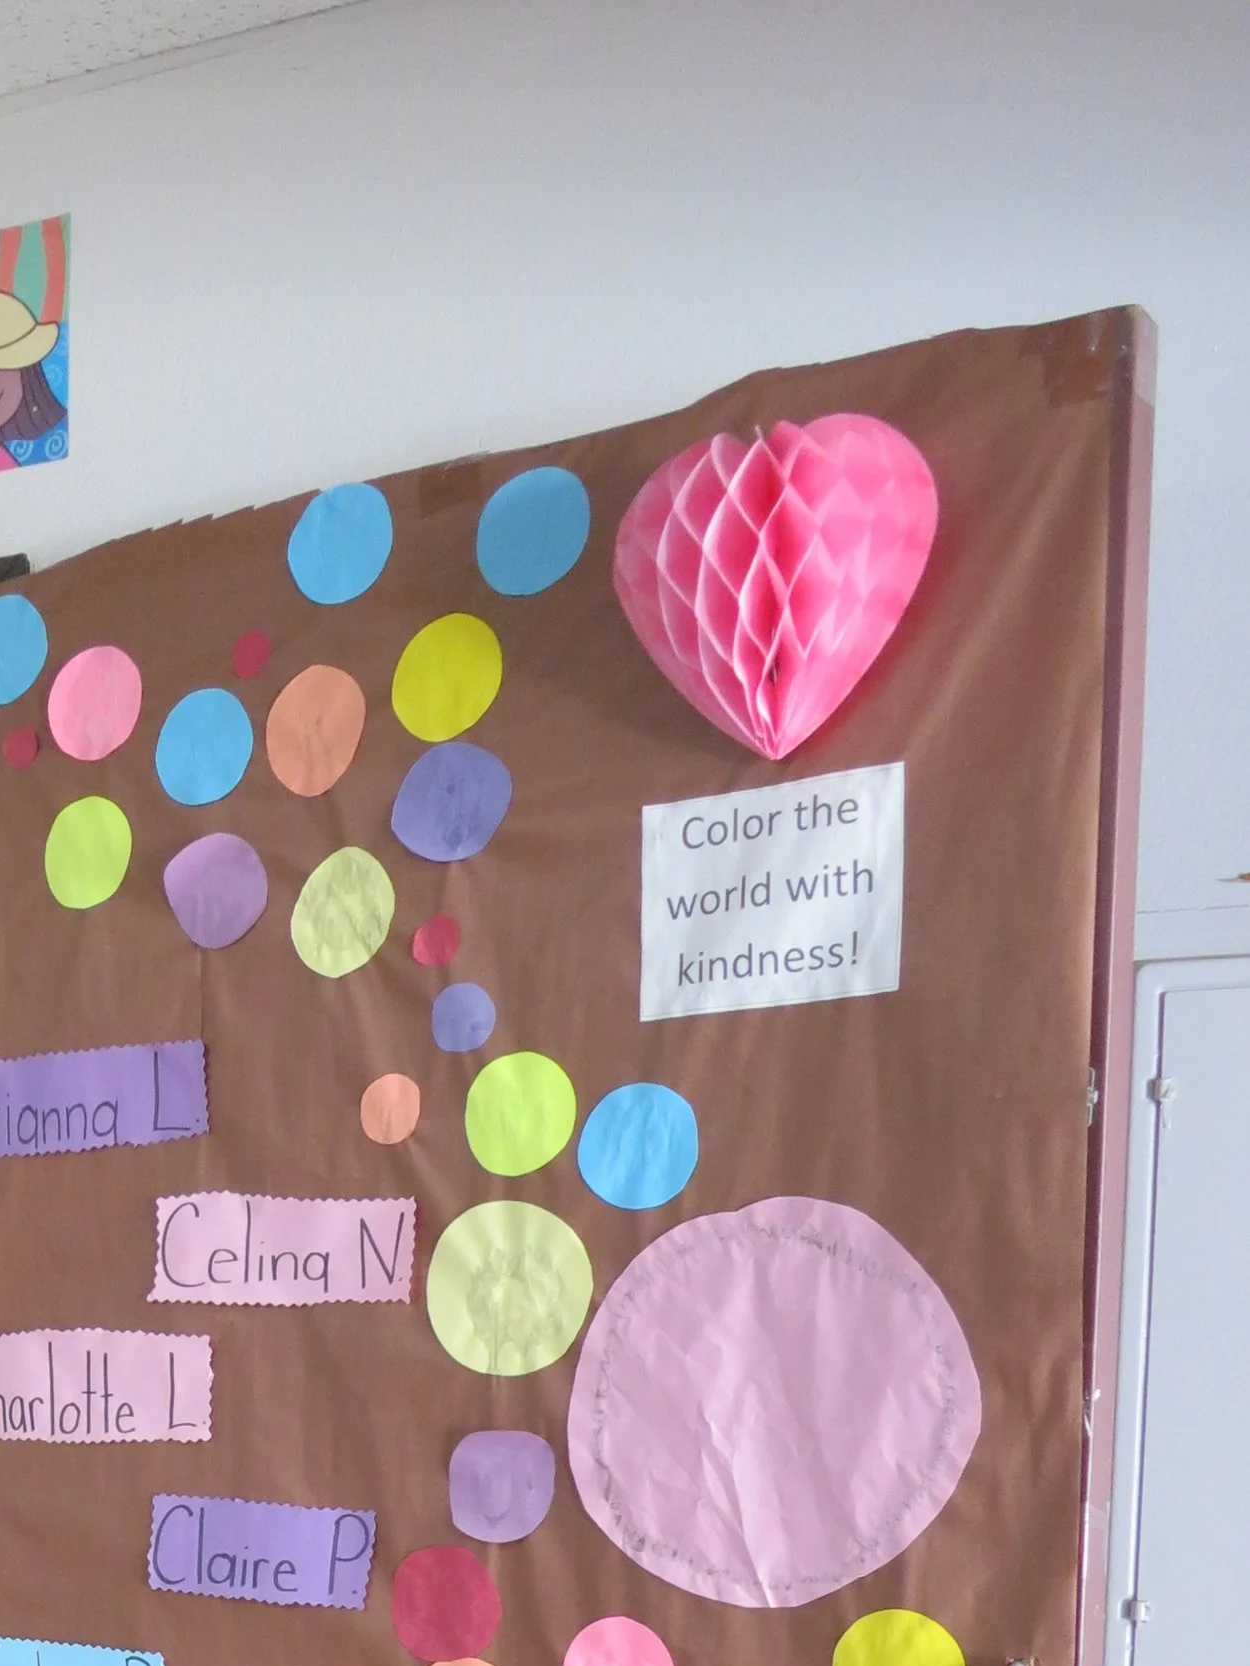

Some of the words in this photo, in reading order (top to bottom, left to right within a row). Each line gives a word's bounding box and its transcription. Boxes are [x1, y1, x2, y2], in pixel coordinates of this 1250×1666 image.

[682, 808, 782, 849] Color
[794, 794, 859, 831] the
[667, 871, 771, 920] world
[786, 859, 874, 902] with
[679, 931, 859, 987] kindness!
[154, 1051, 201, 1132] L.
[161, 1200, 330, 1293] Celina
[361, 1212, 405, 1289] N.
[169, 1352, 208, 1430] L.
[152, 1504, 298, 1592] Claire
[328, 1513, 370, 1596] P.
